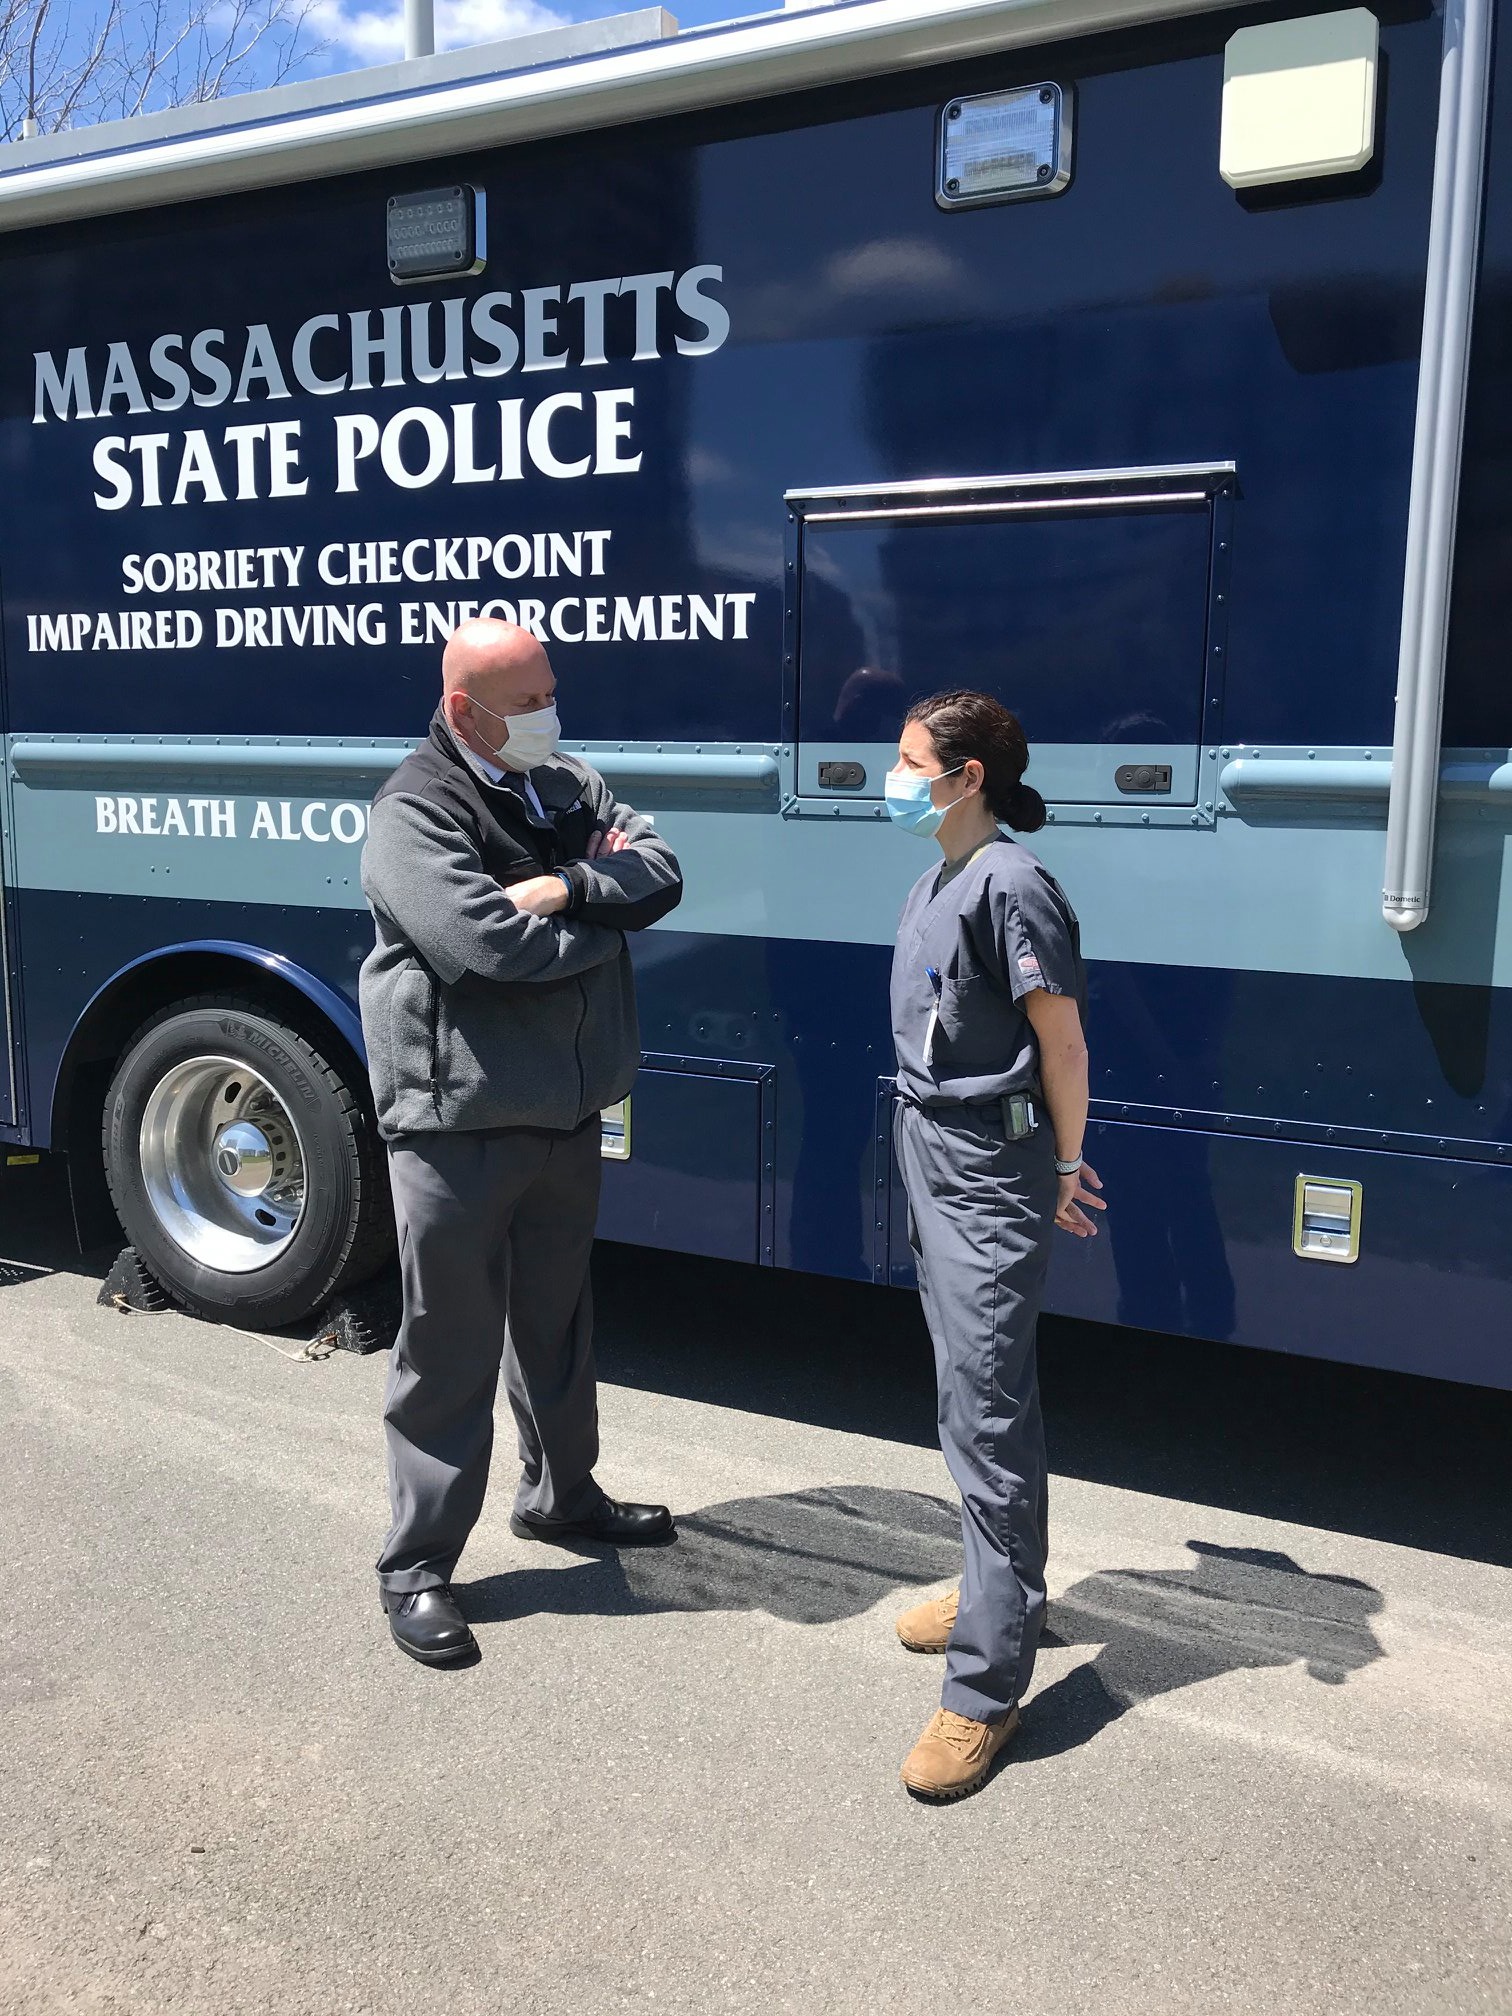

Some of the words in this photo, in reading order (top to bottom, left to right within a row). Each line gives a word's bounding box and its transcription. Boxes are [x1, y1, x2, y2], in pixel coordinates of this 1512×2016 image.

[31, 264, 731, 424] MASSACHUSETTS
[93, 420, 309, 510] STATE
[334, 387, 643, 493] POLICE
[122, 545, 304, 594] SOBRIETY
[318, 530, 612, 585] CHECKPOINT
[27, 610, 202, 652] IMPAIRED
[215, 603, 387, 649] DRIVING
[95, 796, 237, 838] BREATH
[250, 801, 371, 843] ALCO
[1390, 895, 1421, 903] Dometic
[249, 1031, 316, 1099] MICHELIN
